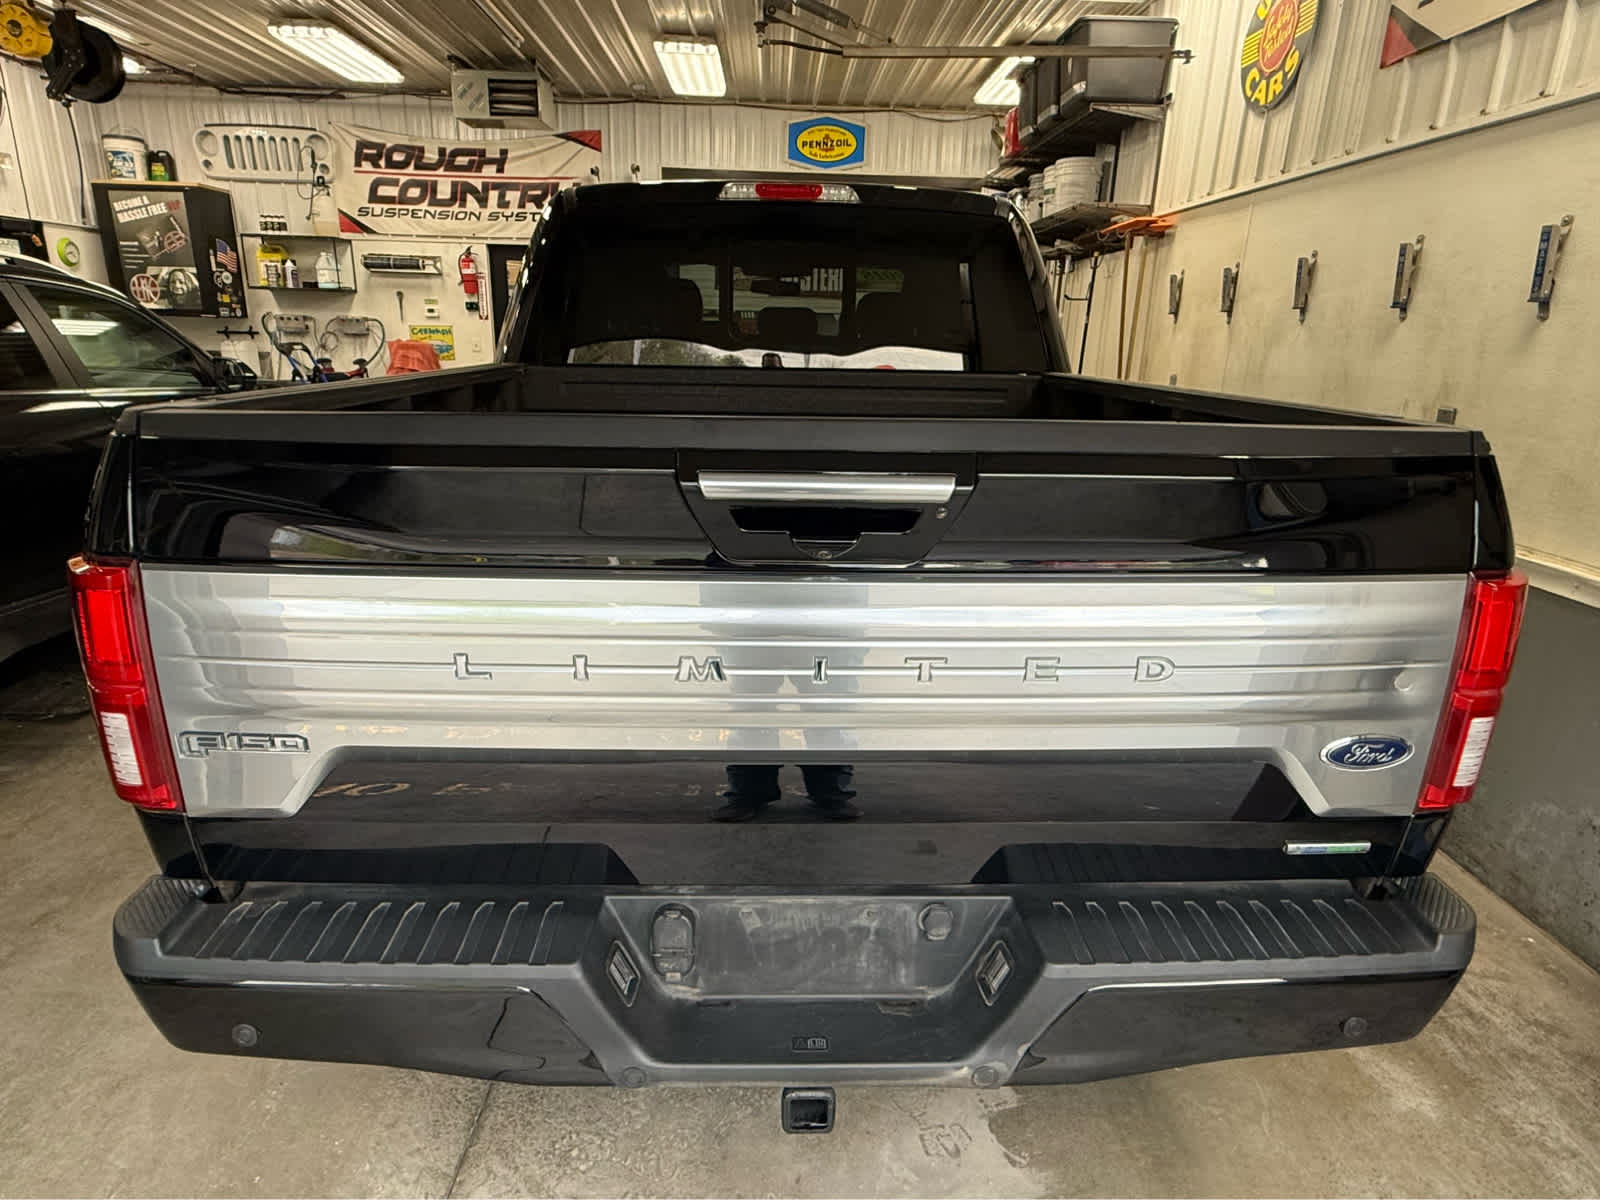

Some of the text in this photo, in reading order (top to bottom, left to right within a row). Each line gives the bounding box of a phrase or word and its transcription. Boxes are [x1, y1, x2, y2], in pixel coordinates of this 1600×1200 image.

[1244, 44, 1301, 106] CARS
[354, 139, 509, 174] ROUGH
[801, 138, 852, 150] PENNZOIL
[357, 206, 543, 222] SUSPENSION SYST
[453, 652, 1177, 684] LIMITED
[1343, 743, 1396, 764] Ford
